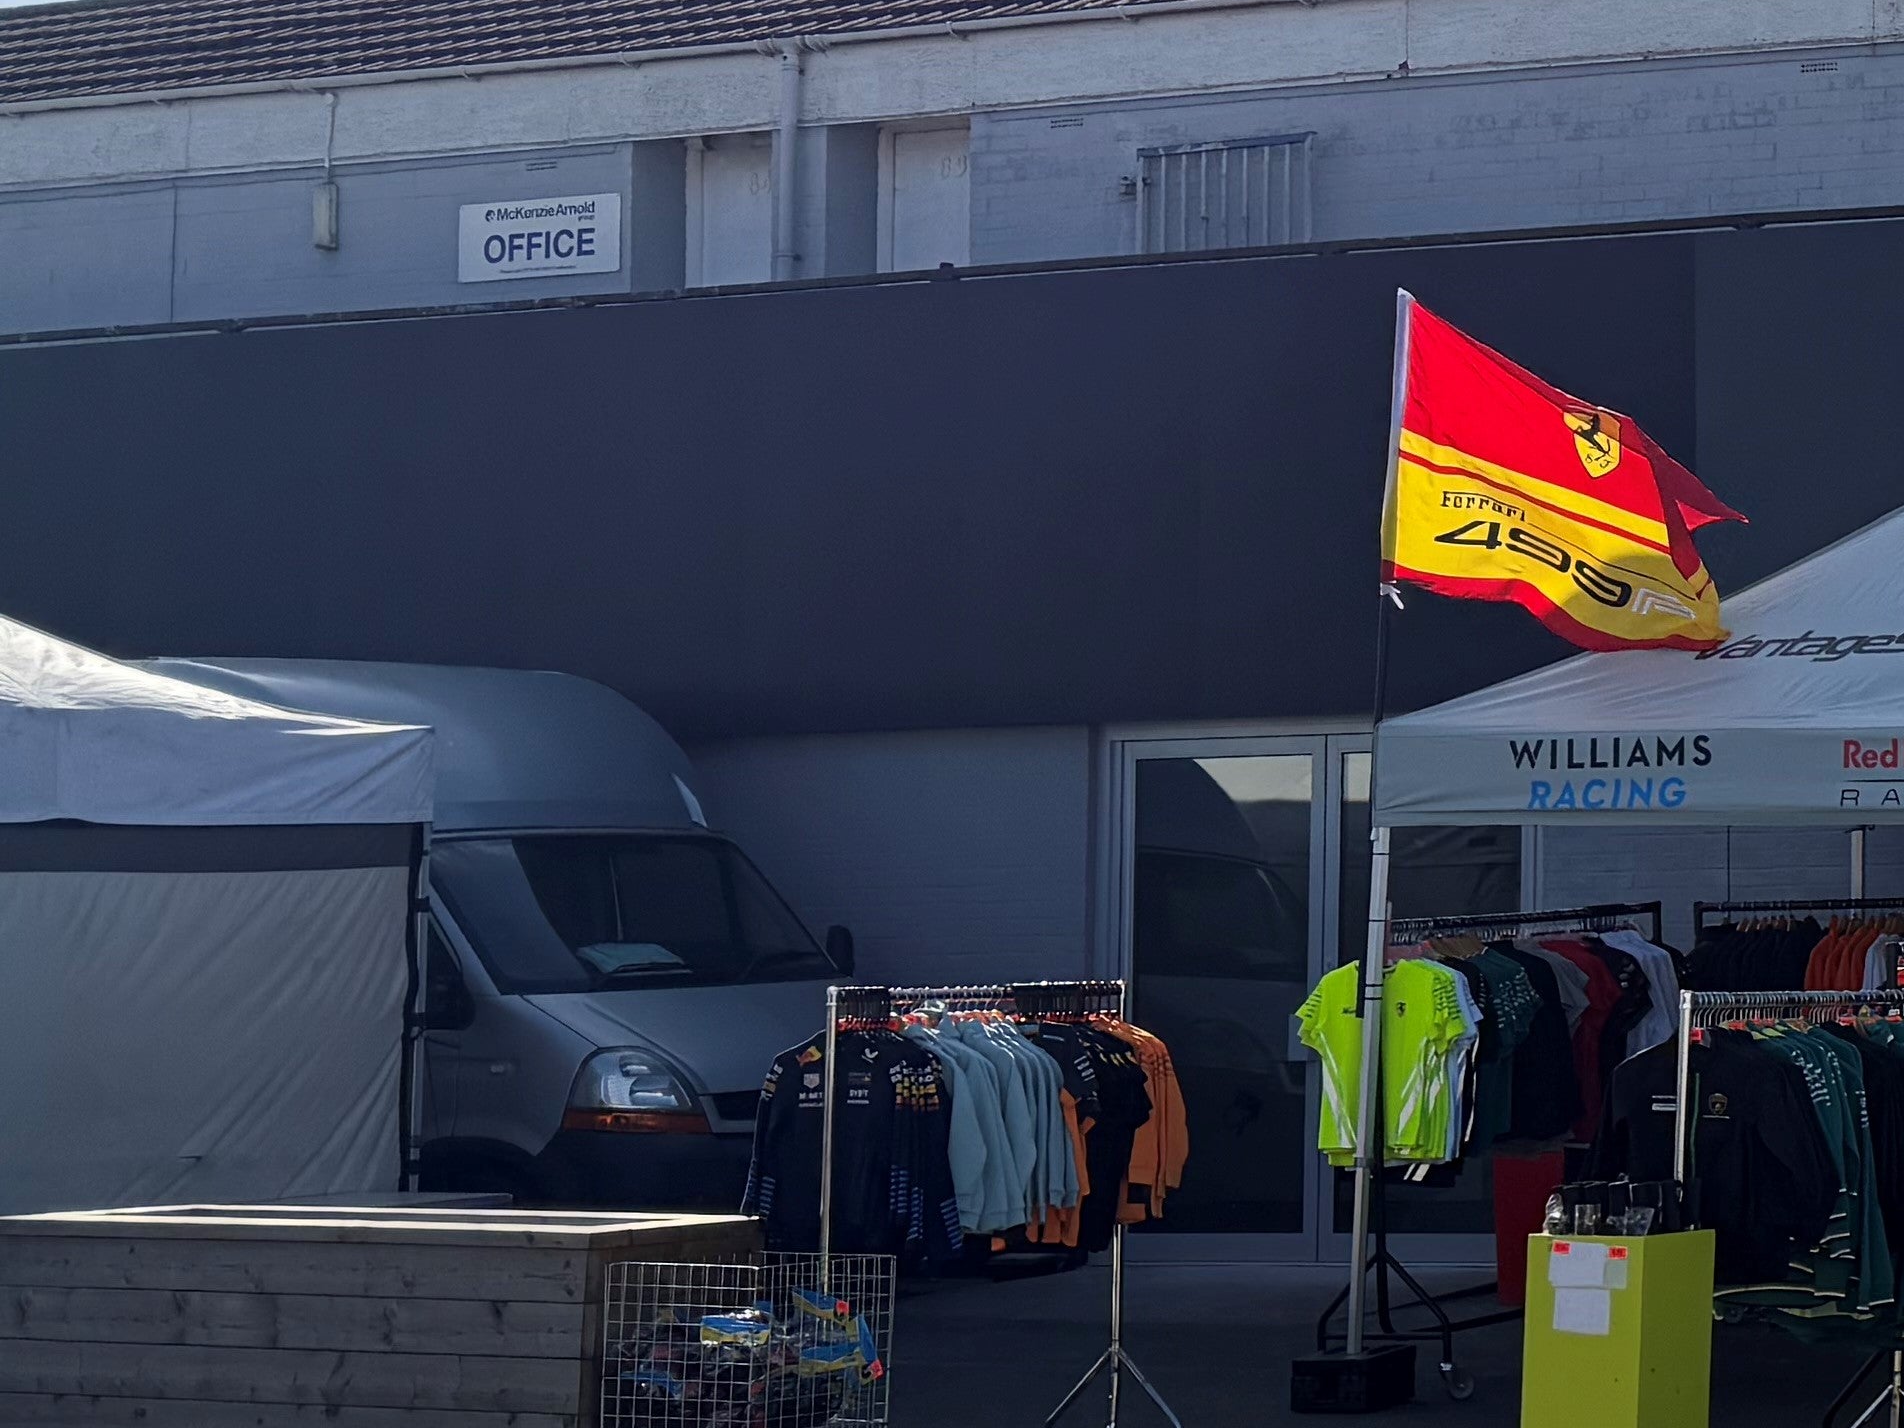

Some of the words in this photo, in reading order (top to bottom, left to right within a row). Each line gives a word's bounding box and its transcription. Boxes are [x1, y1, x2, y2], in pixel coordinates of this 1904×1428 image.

[497, 205, 555, 222] McKenzie
[556, 201, 595, 217] Arnold
[484, 227, 596, 264] OFFICE
[1440, 491, 1527, 522] Ferrari
[1510, 735, 1711, 770] WILLIAMS
[1843, 739, 1900, 769] Red
[1530, 777, 1686, 809] RACING
